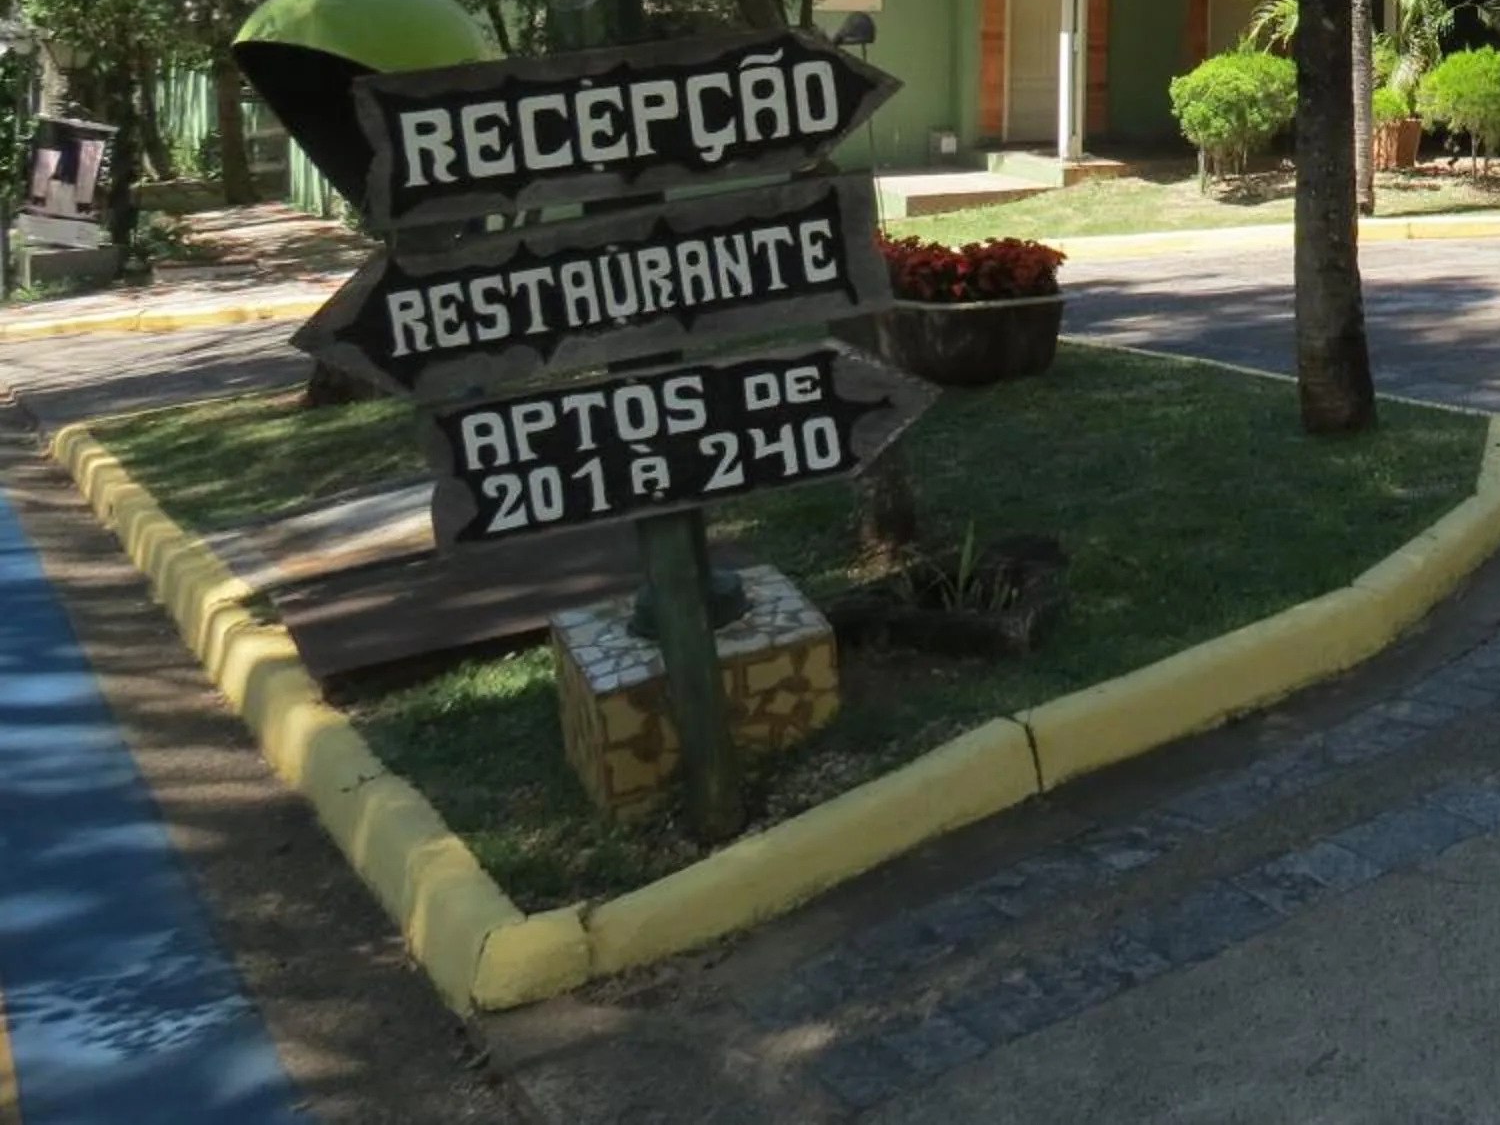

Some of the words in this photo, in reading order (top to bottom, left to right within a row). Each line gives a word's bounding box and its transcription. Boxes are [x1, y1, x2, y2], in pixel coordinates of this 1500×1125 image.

[400, 48, 838, 187] RECEPÇÃO
[387, 219, 837, 356] RESTAURANTE
[461, 376, 707, 470] APTOS
[744, 366, 822, 411] DE
[482, 457, 611, 532] 201
[699, 417, 841, 491] 240
